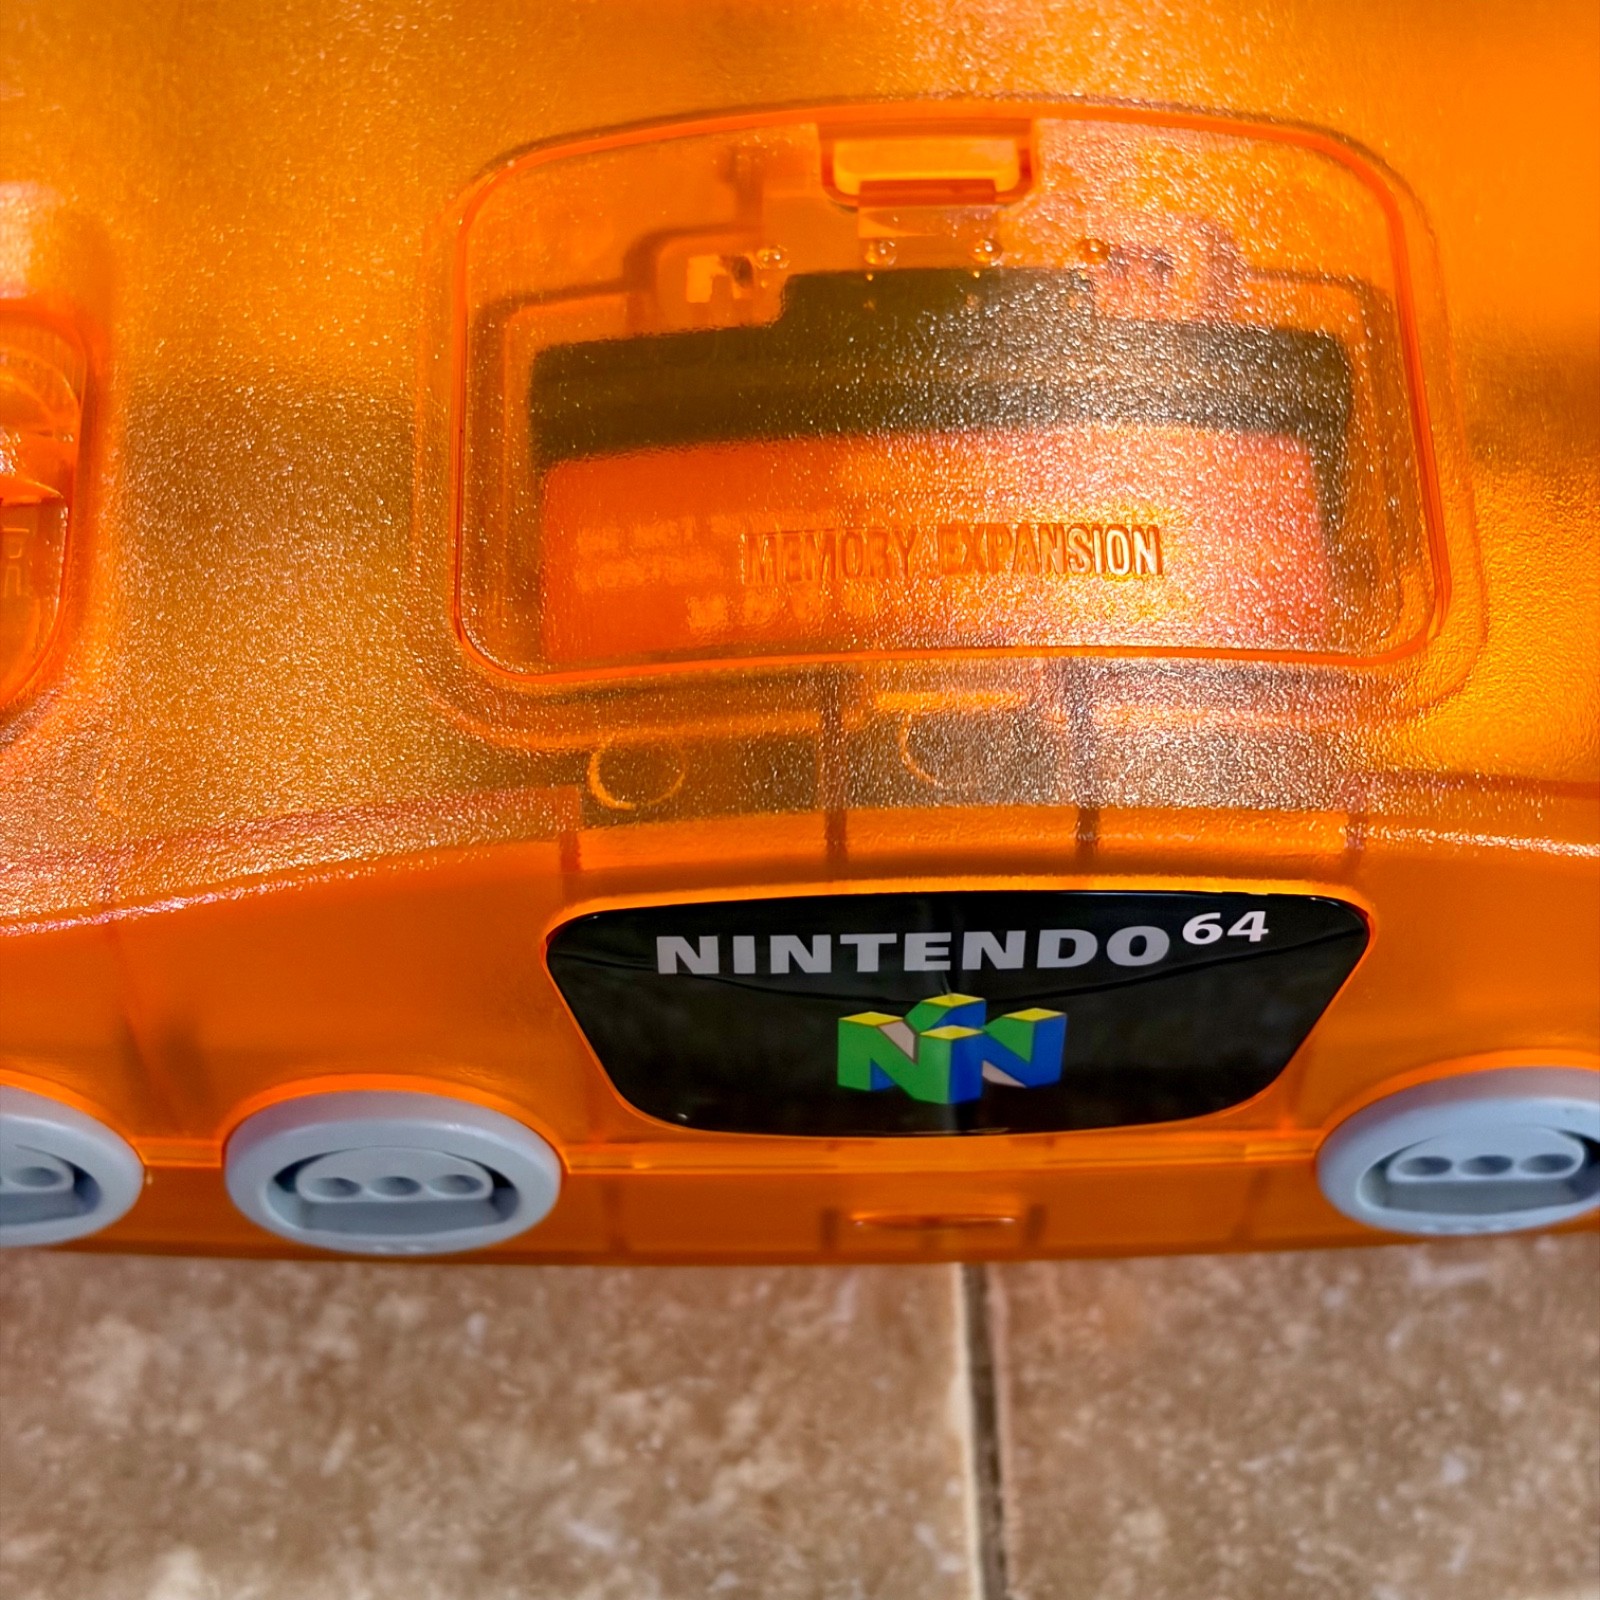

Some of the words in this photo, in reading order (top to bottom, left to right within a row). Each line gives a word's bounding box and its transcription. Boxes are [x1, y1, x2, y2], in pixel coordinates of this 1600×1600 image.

[743, 527, 918, 585] MEMORY
[937, 521, 1164, 577] EXPANSION
[655, 925, 1171, 976] NINTENDO
[1181, 910, 1270, 946] 64
